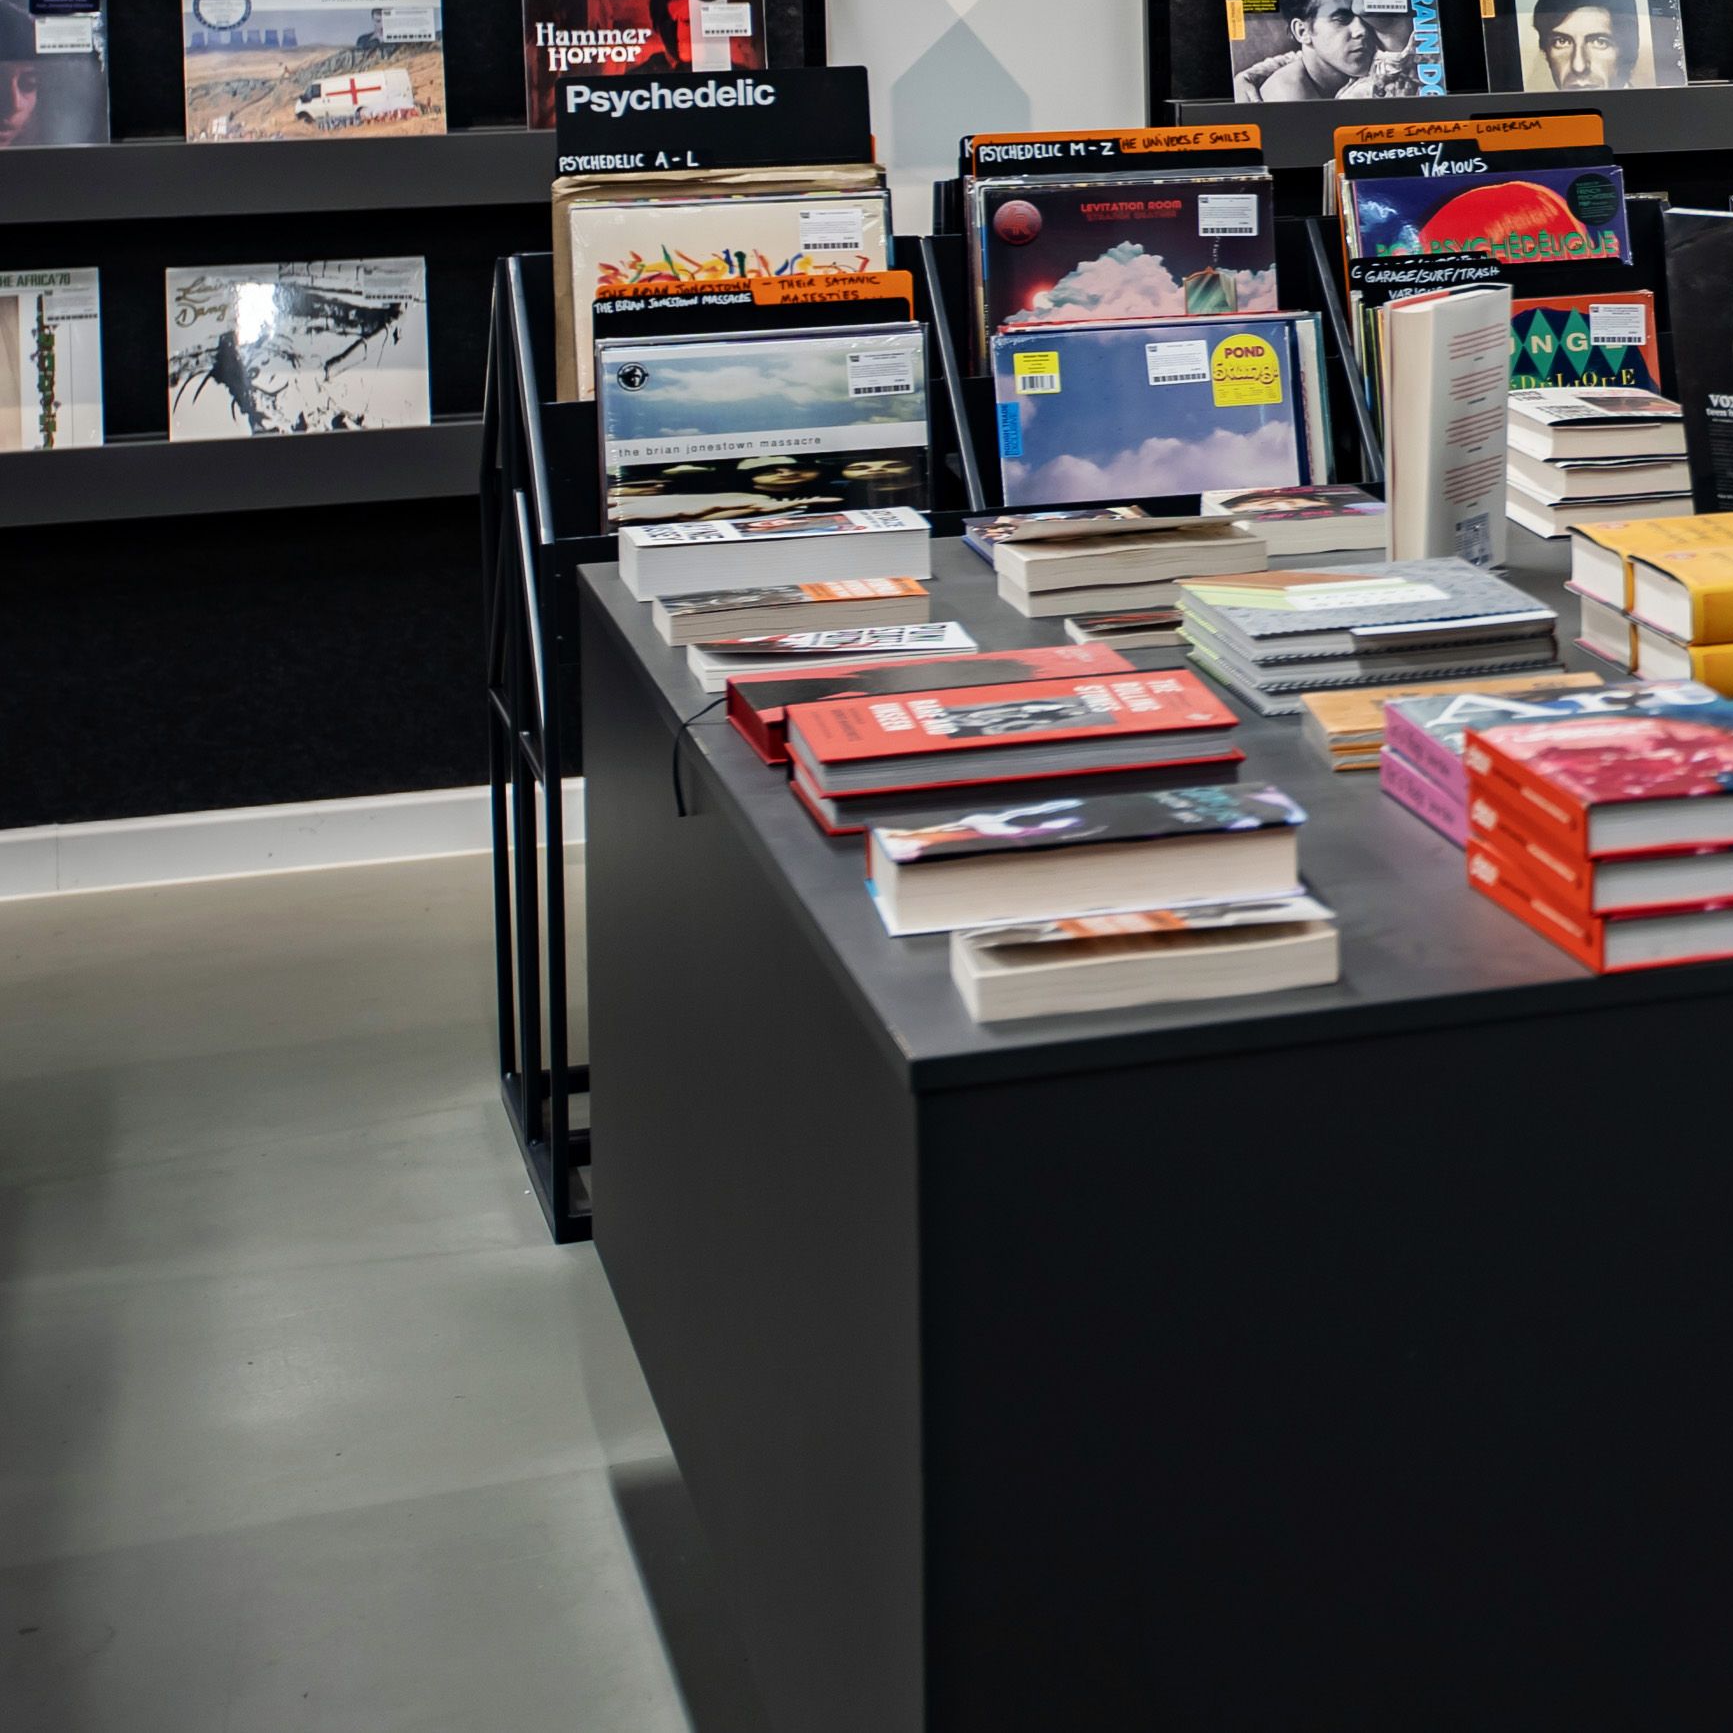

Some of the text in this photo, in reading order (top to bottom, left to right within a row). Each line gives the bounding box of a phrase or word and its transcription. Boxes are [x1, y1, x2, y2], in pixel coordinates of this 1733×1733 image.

[536, 22, 651, 48] Hammer
[547, 43, 642, 71] Horror
[565, 78, 776, 114] Psychedelic
[1209, 130, 1251, 144] SMILES
[1355, 127, 1395, 143] TAME
[1476, 120, 1542, 134] LONERISM
[559, 153, 644, 171] PSYCHEDELIC
[979, 142, 1063, 163] PSYCHEDELIC
[1421, 158, 1488, 178] VARIOUS
[1365, 266, 1500, 283] GARAGE/SURF/TRASH
[1224, 346, 1265, 359] POND
[618, 435, 822, 458] the brian jonestown massacre
